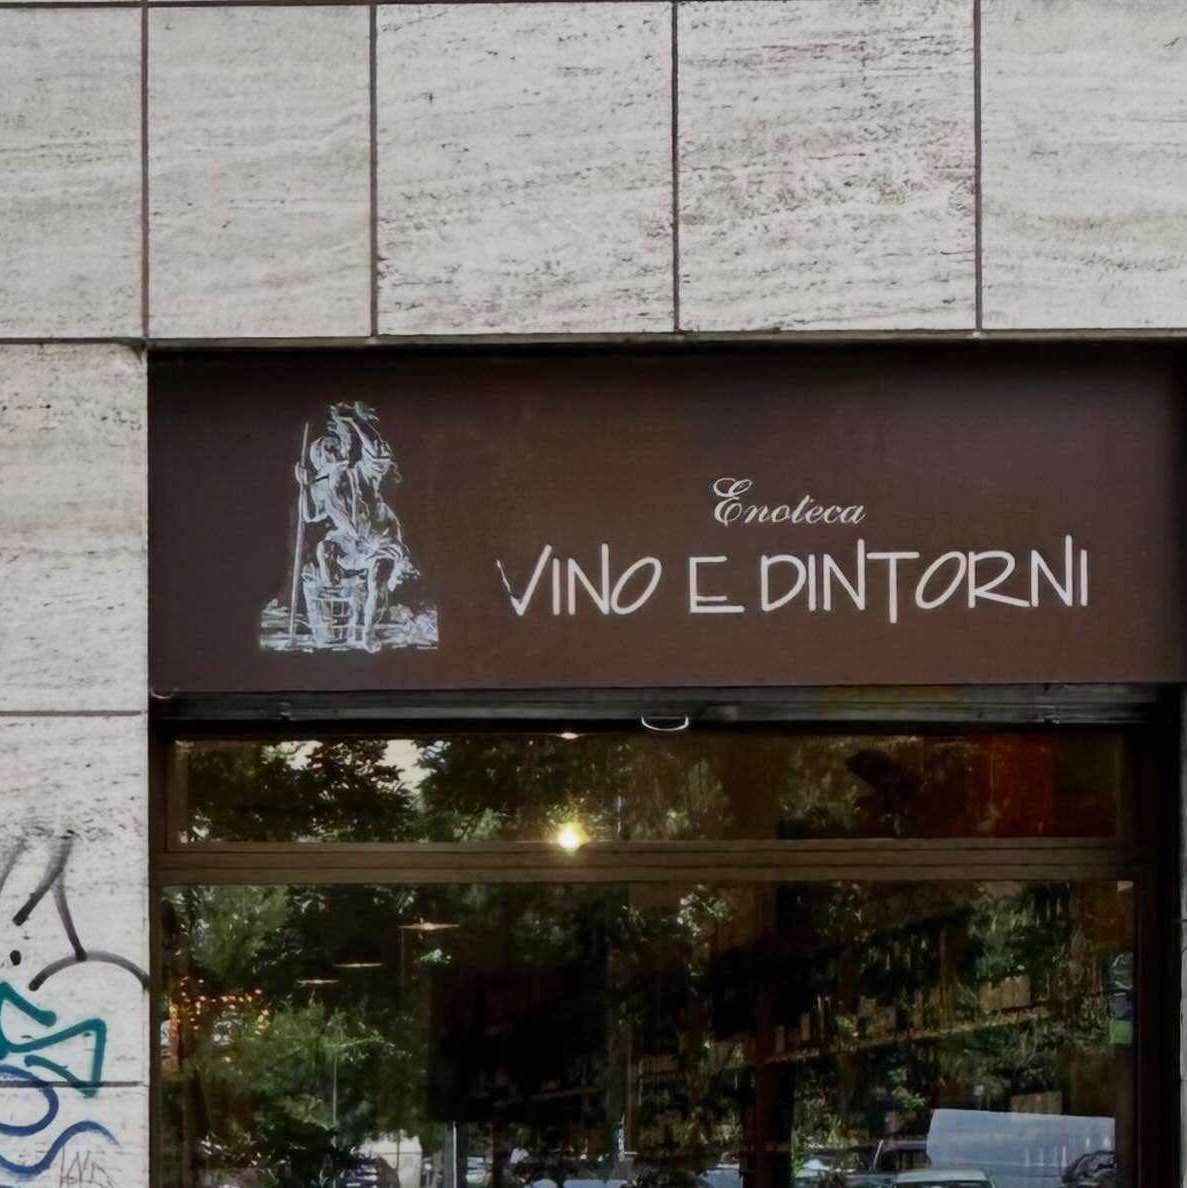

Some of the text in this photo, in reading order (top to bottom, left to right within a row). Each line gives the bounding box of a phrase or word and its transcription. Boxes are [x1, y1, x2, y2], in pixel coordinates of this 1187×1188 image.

[713, 478, 866, 526] Enoteca
[496, 535, 1088, 624] VINO E DINTORNI
